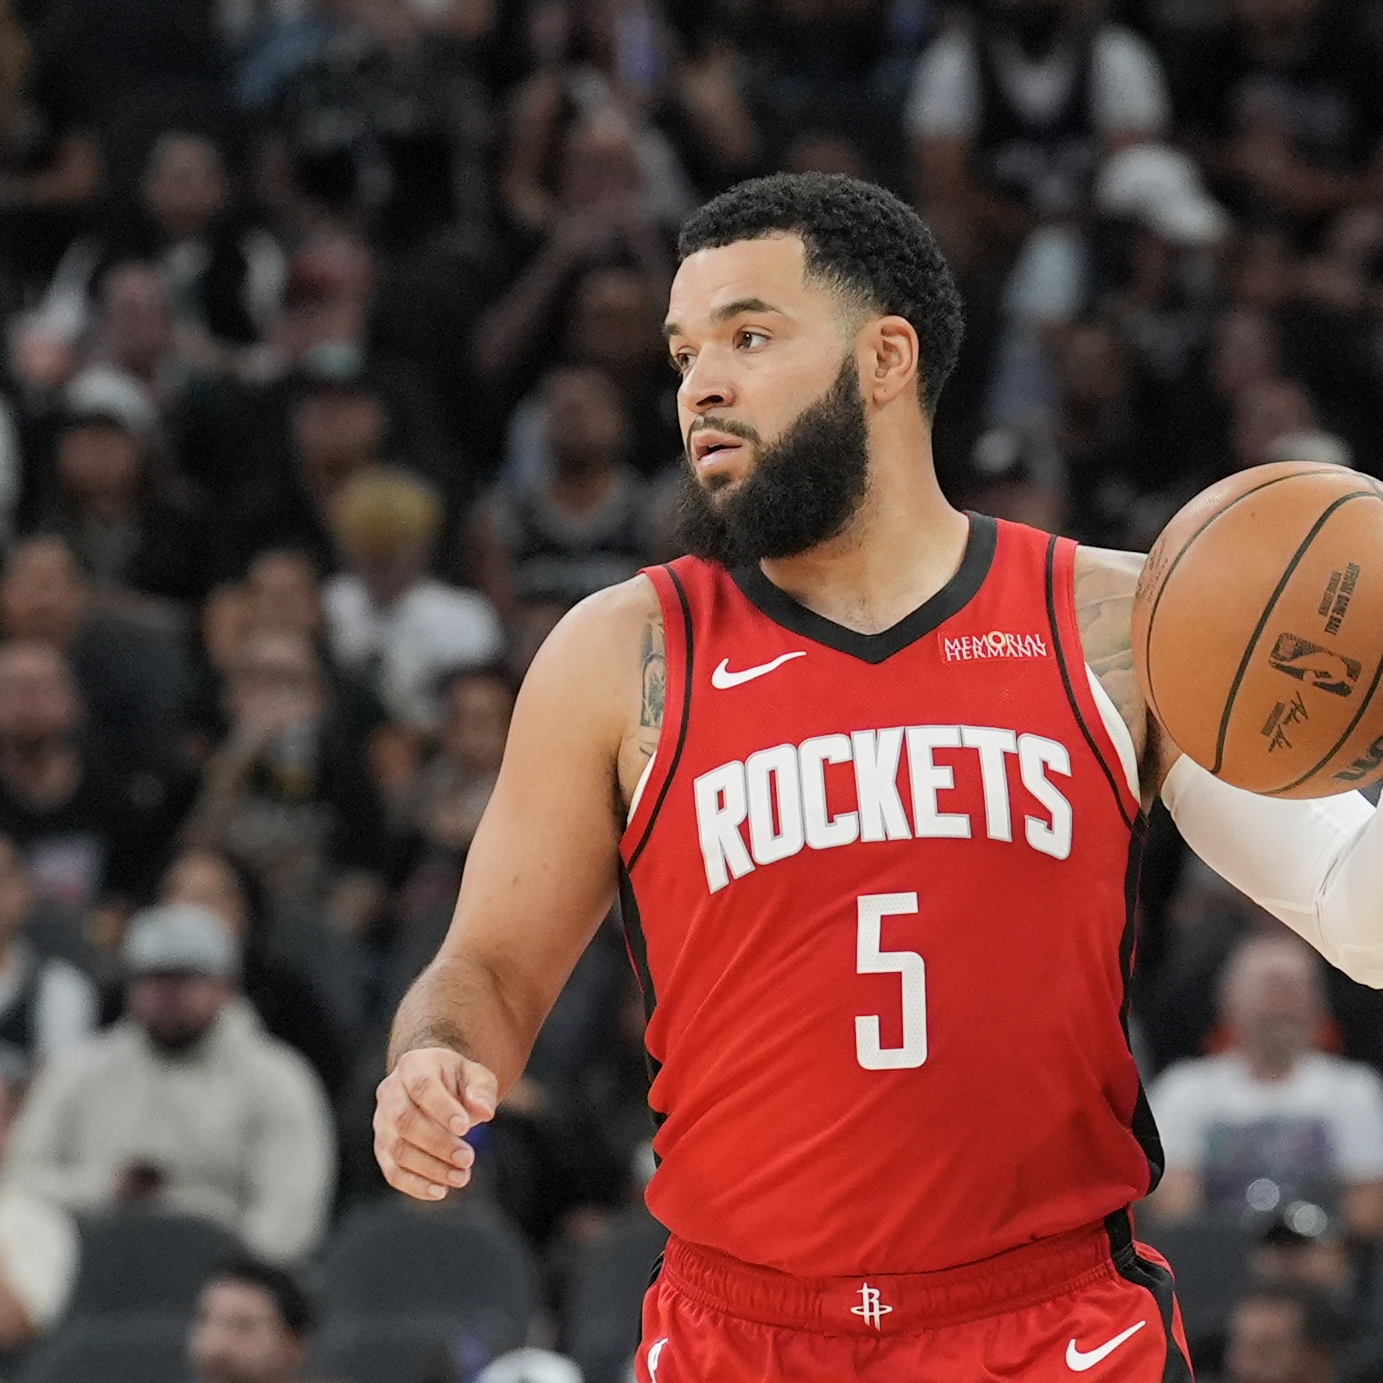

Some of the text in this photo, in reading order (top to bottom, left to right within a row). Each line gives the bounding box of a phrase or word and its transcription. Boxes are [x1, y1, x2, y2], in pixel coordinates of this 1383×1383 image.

[944, 631, 1047, 651] MEMORIAL
[946, 643, 1047, 662] HERMANN
[694, 725, 1073, 895] ROCKETS
[855, 891, 928, 1071] 5
